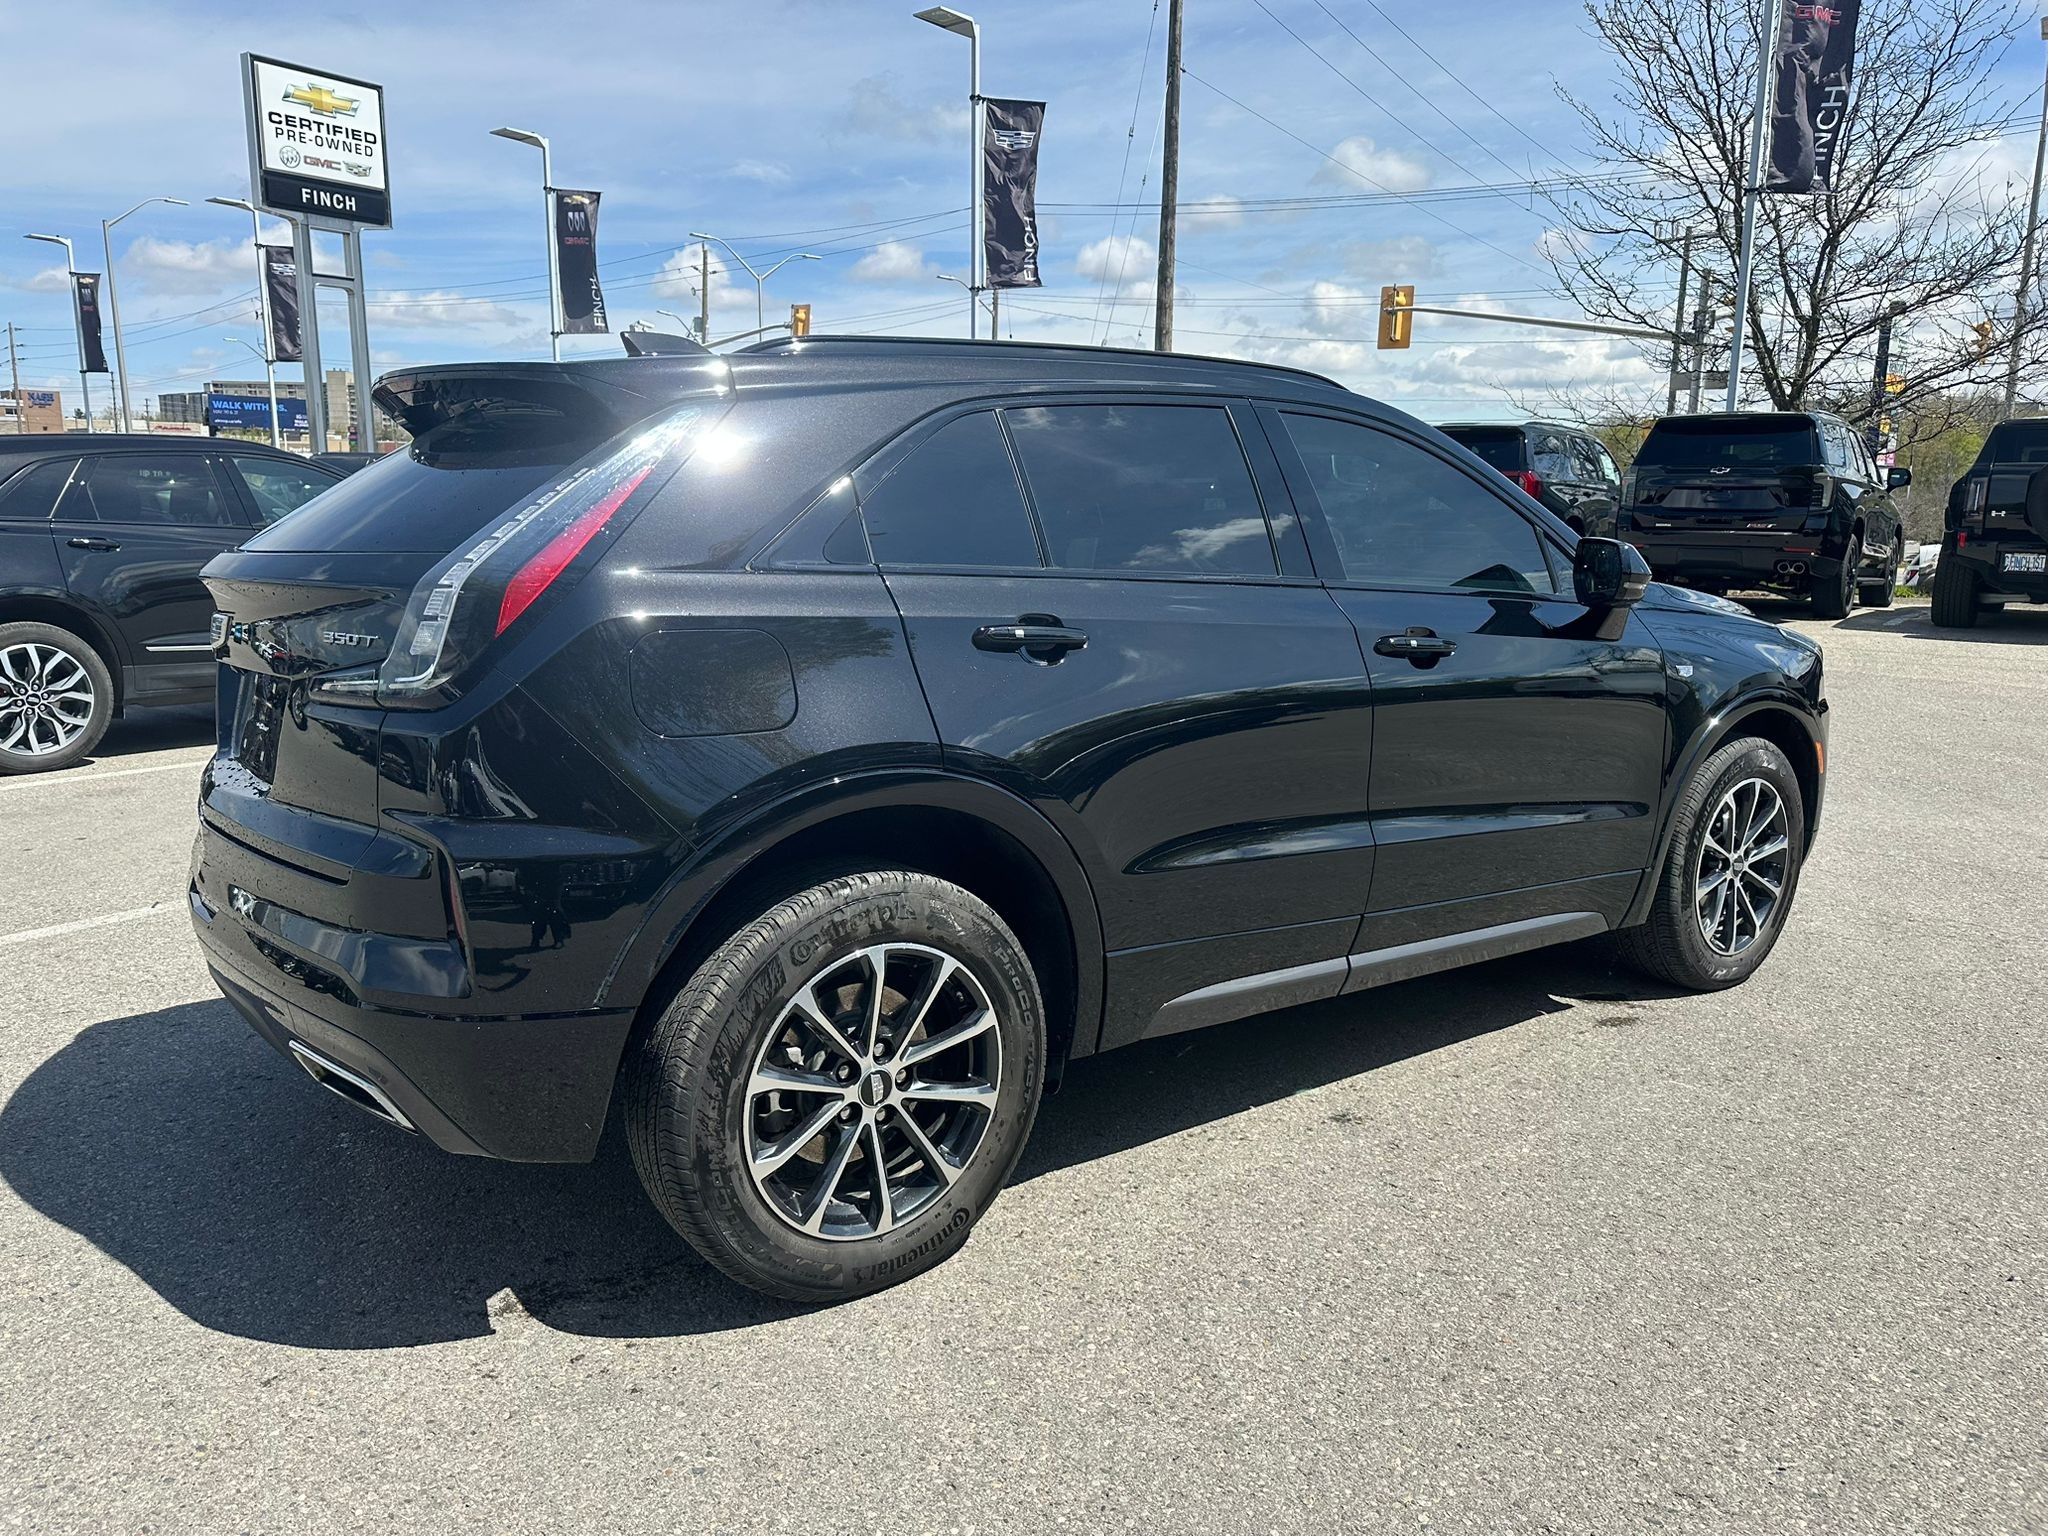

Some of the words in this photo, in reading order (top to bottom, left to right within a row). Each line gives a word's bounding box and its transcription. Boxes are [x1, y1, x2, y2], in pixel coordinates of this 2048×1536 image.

[1795, 5, 1842, 25] GMC
[268, 111, 377, 145] CERTIFIED
[275, 127, 373, 157] PRE-OWNED
[303, 155, 342, 171] GMC
[301, 187, 356, 212] FINCH
[1023, 216, 1037, 281] FINCH
[589, 272, 606, 327] FINCH
[212, 400, 242, 410] WALK
[243, 402, 269, 411] WITH
